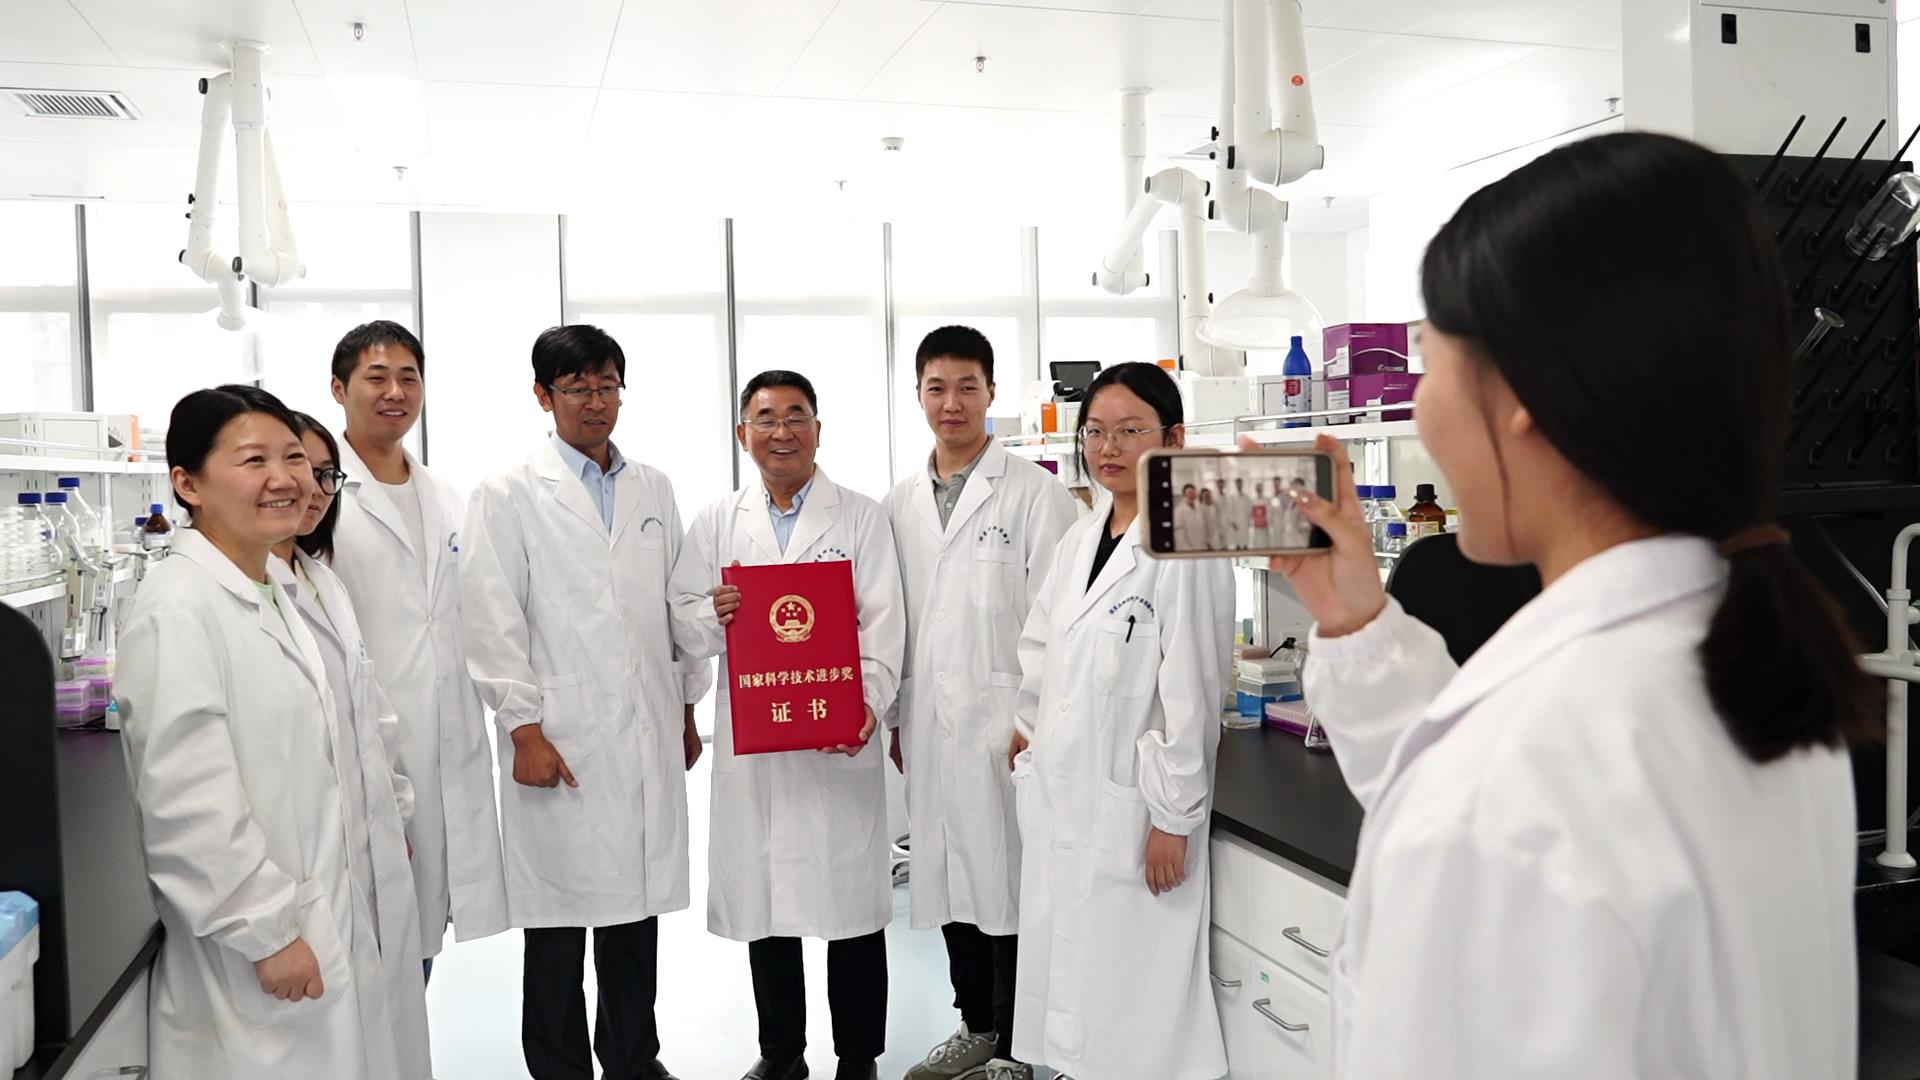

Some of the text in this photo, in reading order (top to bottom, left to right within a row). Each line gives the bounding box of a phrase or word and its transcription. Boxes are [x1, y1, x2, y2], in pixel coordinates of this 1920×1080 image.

[738, 666, 854, 689] 国家科学技术进步奖
